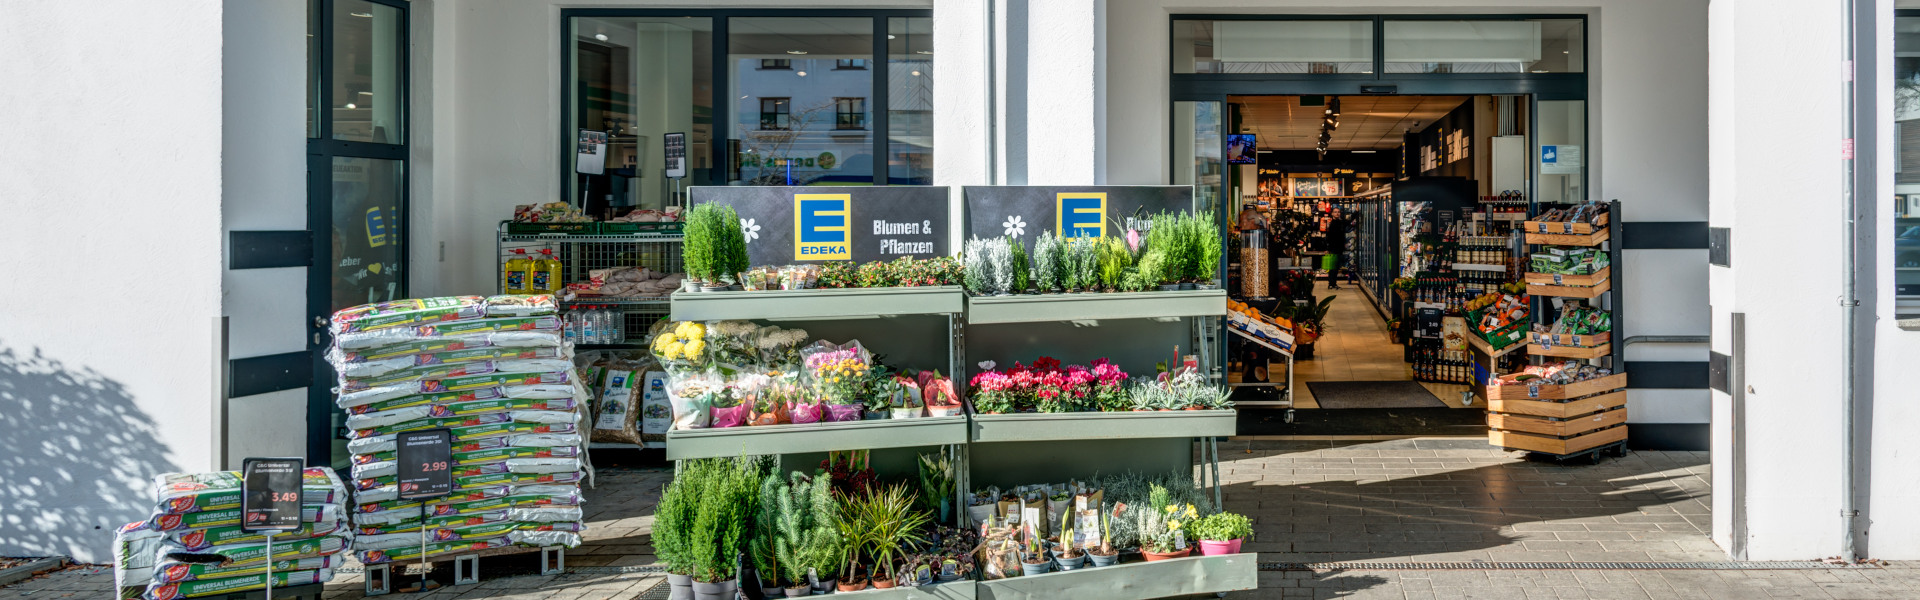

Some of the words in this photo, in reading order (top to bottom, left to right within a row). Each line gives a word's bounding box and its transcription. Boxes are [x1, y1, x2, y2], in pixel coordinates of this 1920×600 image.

[801, 200, 845, 242] E
[873, 219, 920, 235] Blumen
[922, 219, 932, 235] &
[801, 246, 847, 255] EDEKA
[880, 239, 934, 254] Pflanzen
[422, 461, 448, 472] 2.99
[209, 495, 241, 503] UNIVERSAL
[271, 492, 298, 502] 3.49
[196, 512, 228, 520] UNIVERSAL
[258, 544, 293, 554] BLUENERDE
[193, 581, 224, 590] UNIVERSAL
[224, 575, 261, 586] BLUMENERDE
